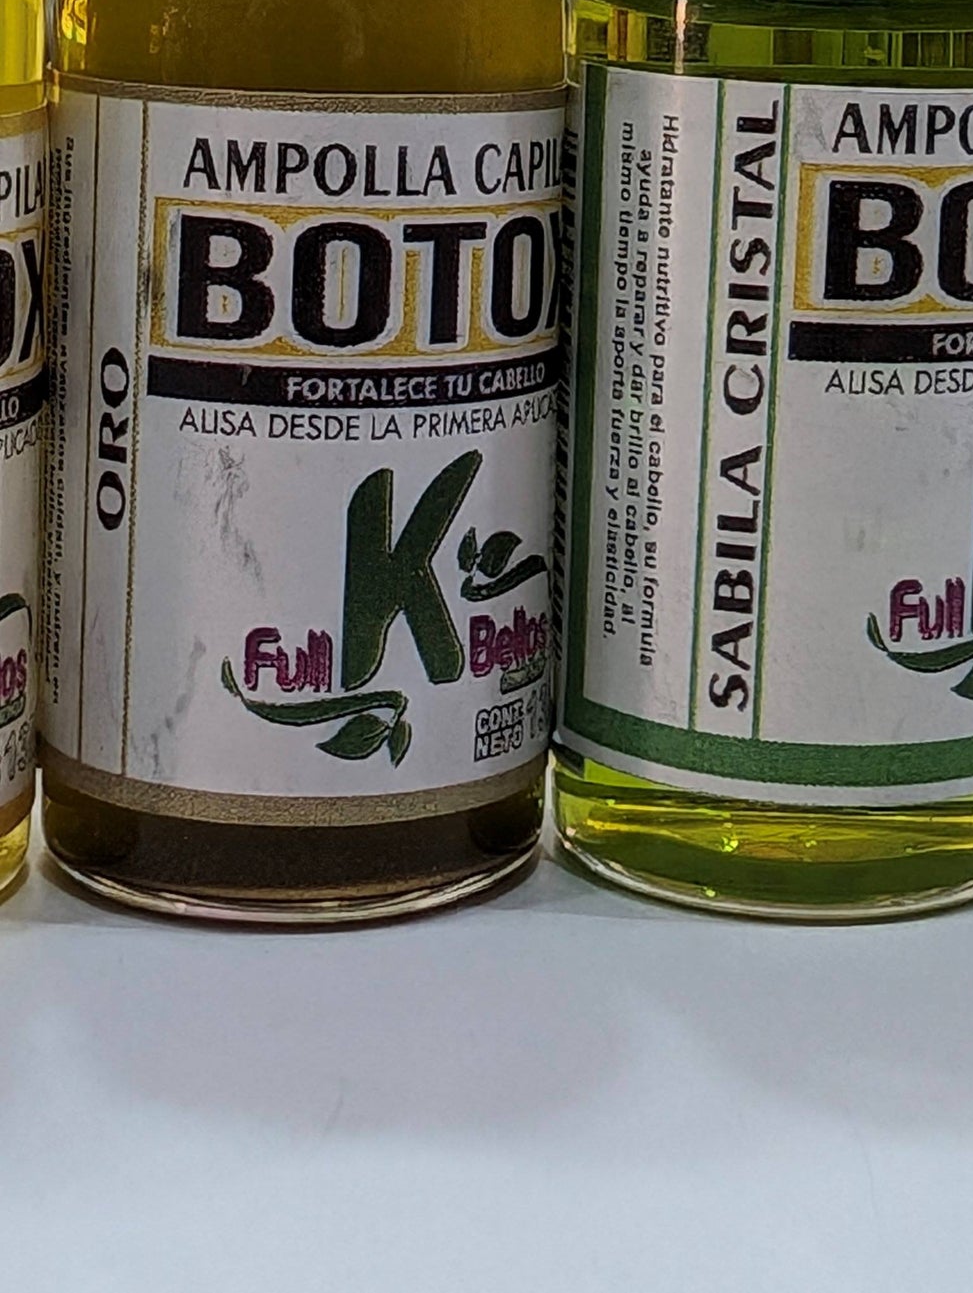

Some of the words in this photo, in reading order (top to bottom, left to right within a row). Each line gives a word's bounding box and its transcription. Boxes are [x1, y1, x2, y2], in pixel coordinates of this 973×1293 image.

[182, 137, 457, 197] AMPOLLA
[621, 121, 636, 202] mismo
[637, 150, 652, 221] ayuda
[616, 211, 634, 291] tiempo
[636, 229, 650, 243] a
[723, 98, 780, 416] CRISTAL
[632, 249, 649, 341] reparar
[654, 246, 671, 346] nutritivo
[612, 326, 626, 400] aporta
[630, 341, 645, 357] y
[286, 375, 439, 402] FORTALECE
[446, 375, 473, 398] TU
[477, 360, 547, 395] CABELLO
[631, 363, 646, 401] dar
[650, 354, 666, 406] para
[824, 368, 905, 396] ALISA
[97, 346, 130, 531] ORO
[178, 406, 257, 437] ALISA
[267, 413, 361, 441] DESDE
[370, 414, 404, 441] LA
[413, 405, 507, 439] PRIMERA
[608, 408, 625, 479] fuerza
[629, 409, 645, 469] brillo
[650, 413, 665, 433] el
[605, 485, 619, 501] y
[627, 477, 641, 498] al
[243, 626, 333, 693] Full
[340, 448, 484, 693] K
[644, 541, 657, 568] su
[708, 445, 763, 713] SABILA
[889, 576, 966, 643] Full
[473, 724, 524, 763] NETO
